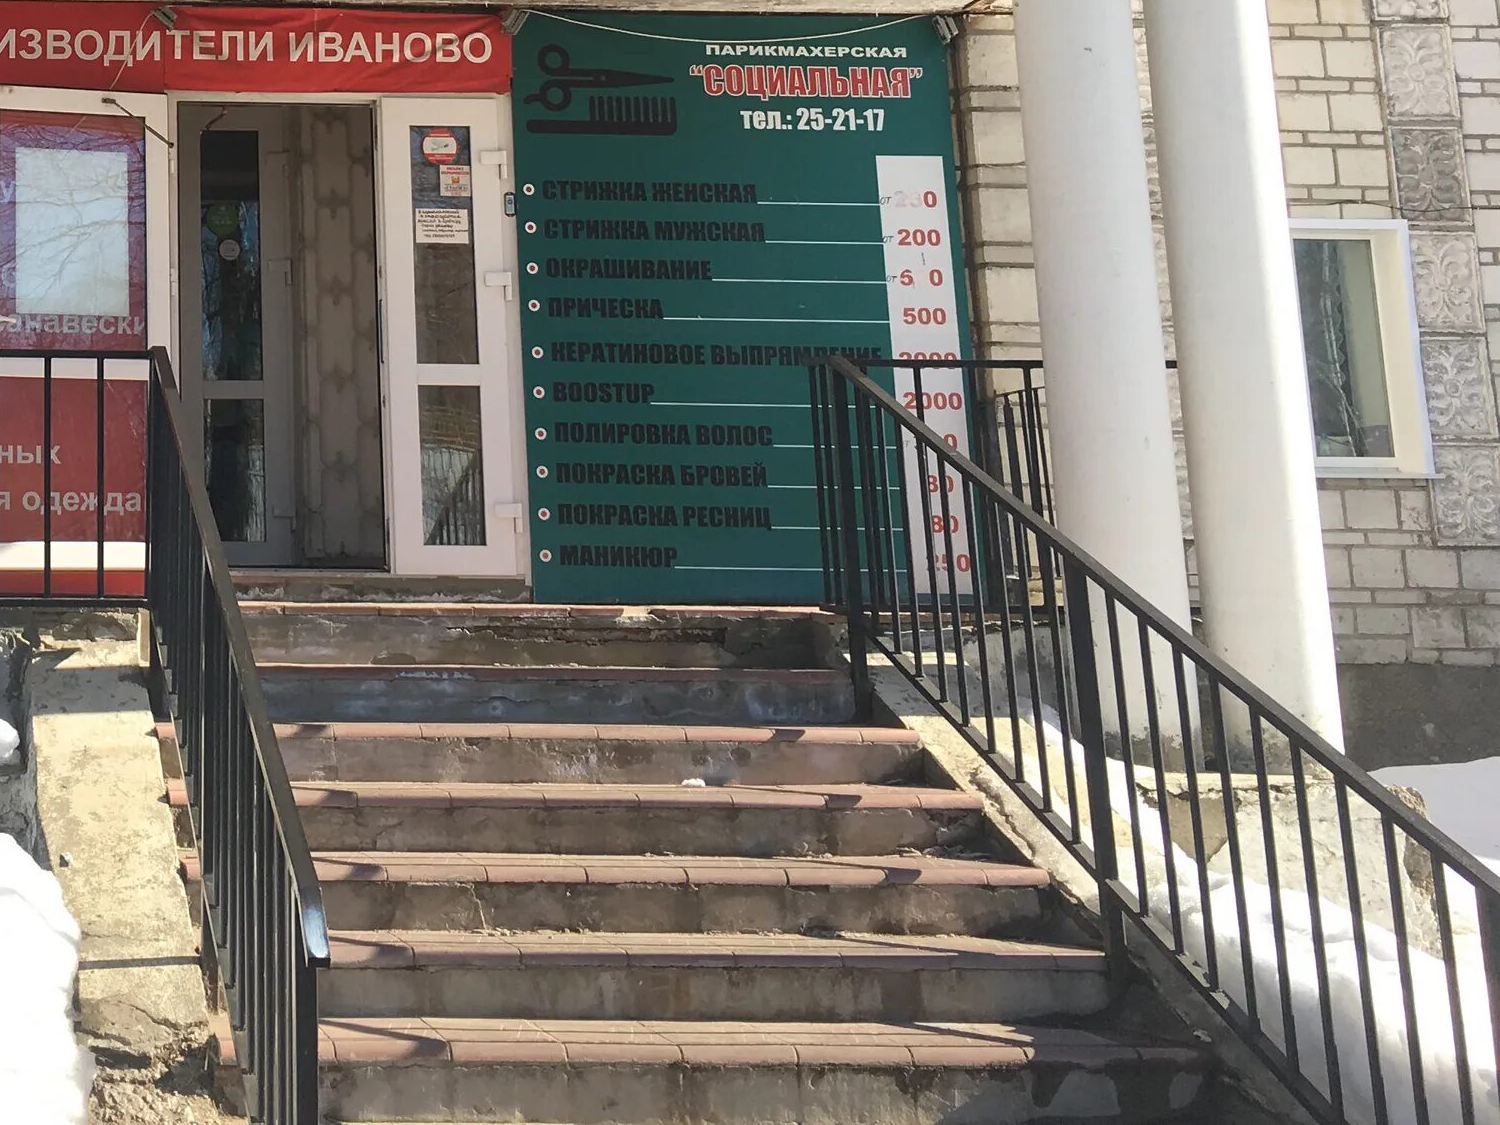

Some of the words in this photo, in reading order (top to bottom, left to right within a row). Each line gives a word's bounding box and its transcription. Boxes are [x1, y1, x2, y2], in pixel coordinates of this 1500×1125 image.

[288, 31, 493, 64] ИВАНОВО
[705, 44, 908, 59] ПАРИКМАХЕРСКАЯ
[740, 109, 793, 130] тел.:
[796, 106, 886, 132] 25-21-17
[542, 179, 648, 202] СТРИЖКА
[651, 181, 758, 204] ЖЕНСКАЯ
[544, 218, 649, 241] СТРИЖКА
[654, 220, 765, 243] МУЖСКАЯ
[897, 228, 941, 247] 200
[545, 257, 713, 280] ОКРАШИВАНИЕ
[548, 297, 664, 319] ПРИЧЕСКА
[903, 307, 947, 325] 500
[551, 341, 706, 366] КЕРАТИНОВОЕ
[553, 381, 655, 404] BOOSTUP
[903, 391, 963, 410] 2000
[554, 421, 691, 445] ПОЛИРОВКА
[696, 424, 773, 447] ВОЛОС
[556, 462, 676, 486] ПОКРАСКА
[680, 461, 767, 488] БРОВЕЙ
[557, 503, 678, 527] ПОКРАСКА
[682, 505, 772, 531] РЕСНИЦ
[559, 544, 677, 568] МАНИКЮР
